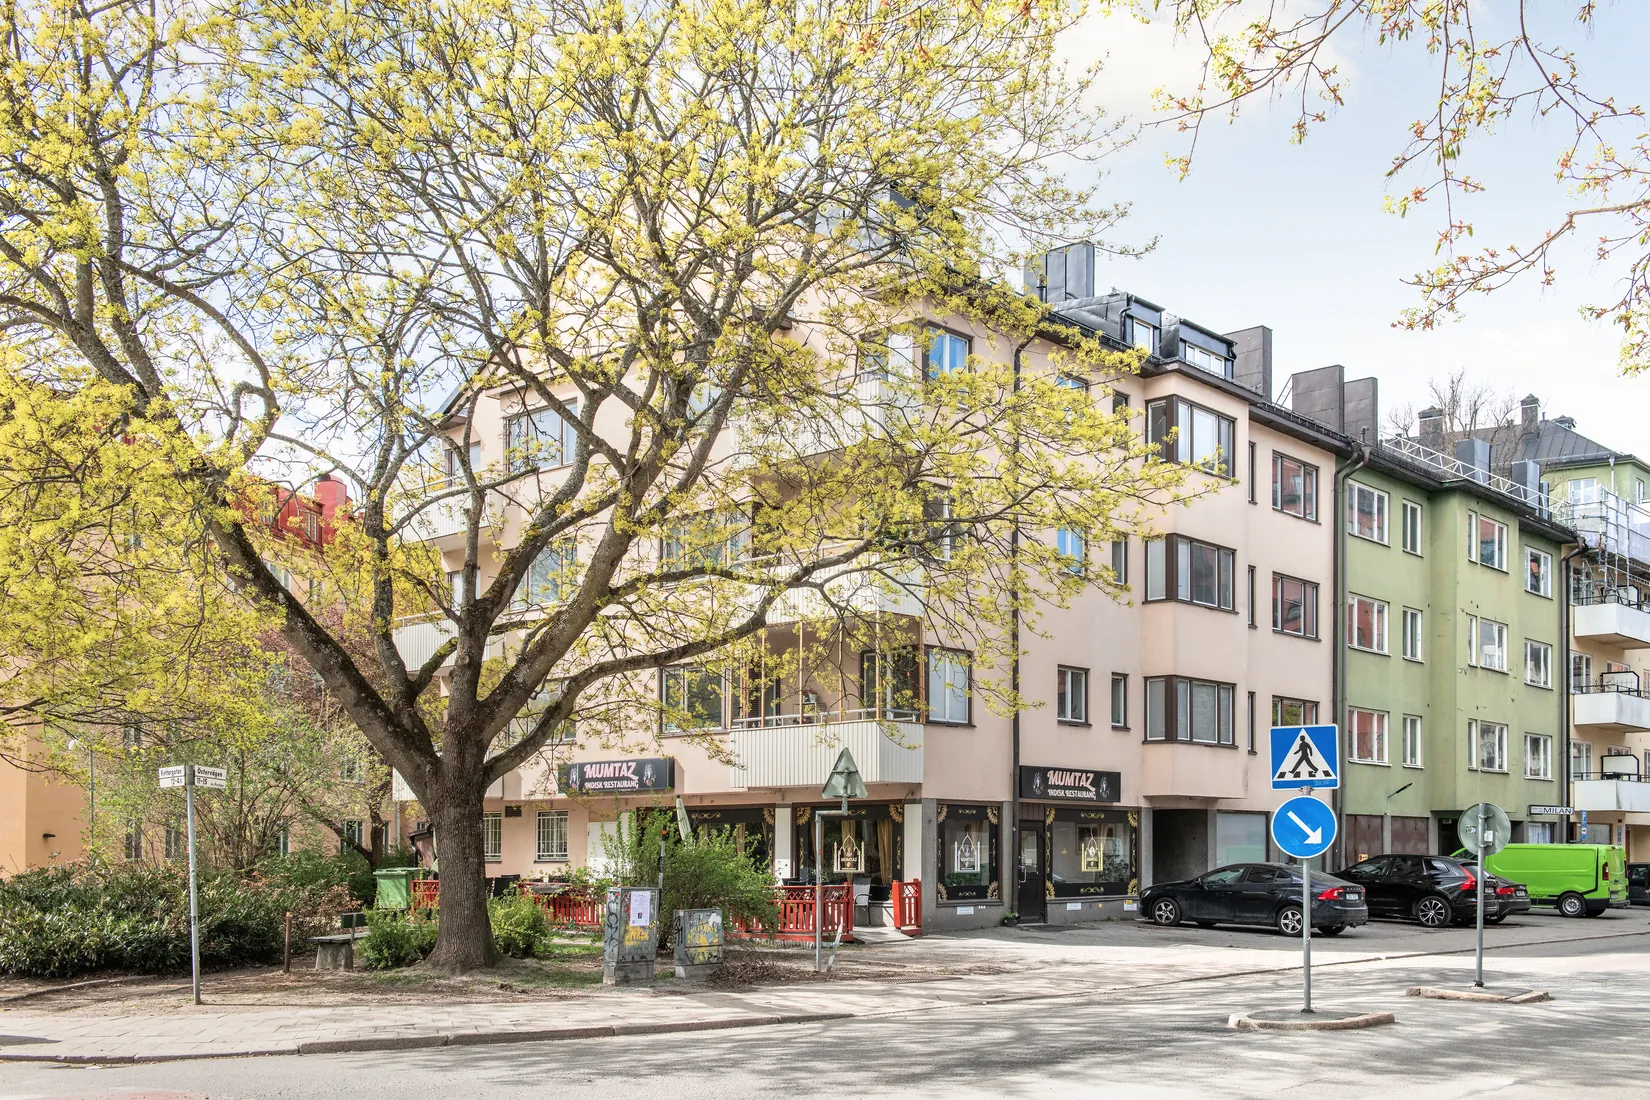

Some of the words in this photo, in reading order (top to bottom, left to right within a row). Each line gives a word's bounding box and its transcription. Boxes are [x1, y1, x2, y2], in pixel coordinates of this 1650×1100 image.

[196, 767, 223, 778] Östervägen
[584, 762, 639, 780] MUMTAZ
[584, 781, 603, 789] INDISK
[603, 780, 639, 789] RESTAURANG
[1047, 770, 1096, 791] MUMTAZ
[1048, 789, 1065, 797] INDISK
[1065, 790, 1096, 800] RESTAURANG
